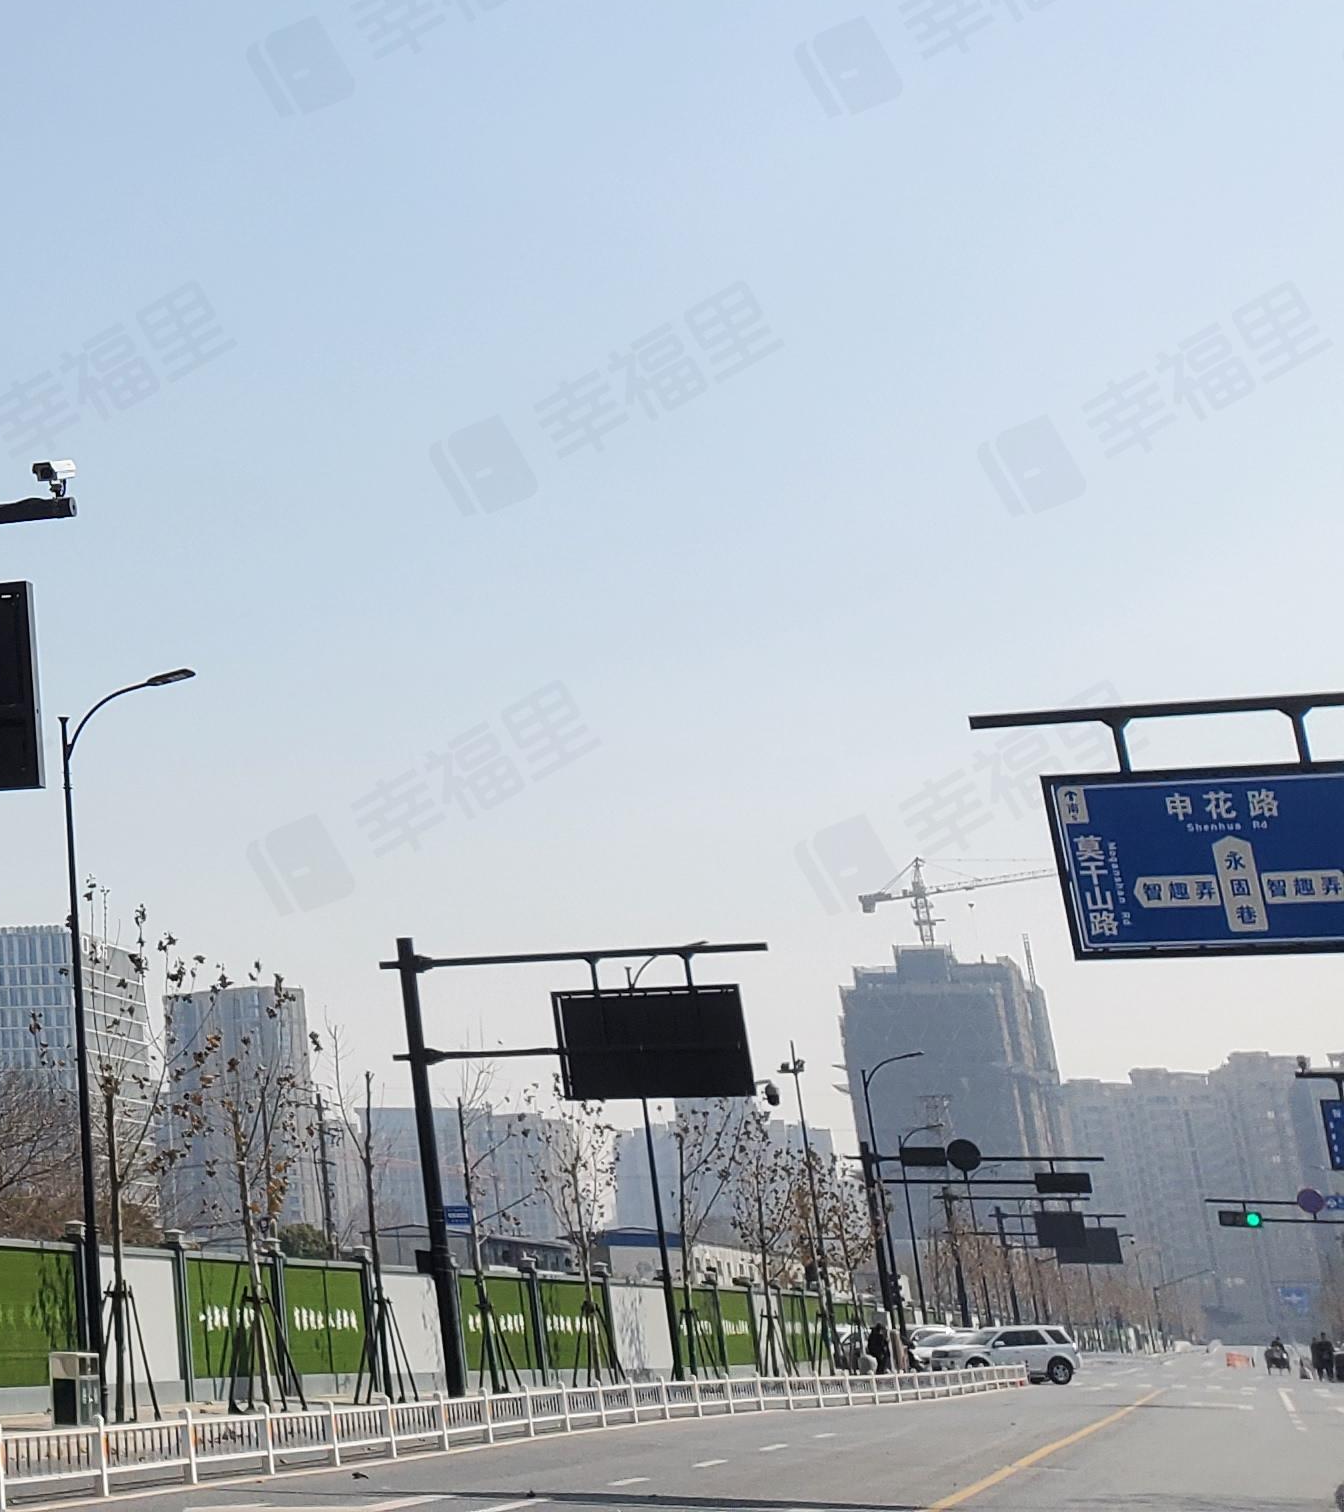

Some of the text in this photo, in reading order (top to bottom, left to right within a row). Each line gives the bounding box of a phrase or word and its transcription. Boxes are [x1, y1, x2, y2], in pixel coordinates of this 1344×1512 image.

[1165, 789, 1279, 821] 申花路
[1186, 820, 1268, 832] Shenhua Rd
[1073, 835, 1119, 936] 莫干山路
[1143, 880, 1216, 901] 智趣弄
[1224, 851, 1257, 925] 永固巷
[1266, 876, 1343, 898] 智趣弄
